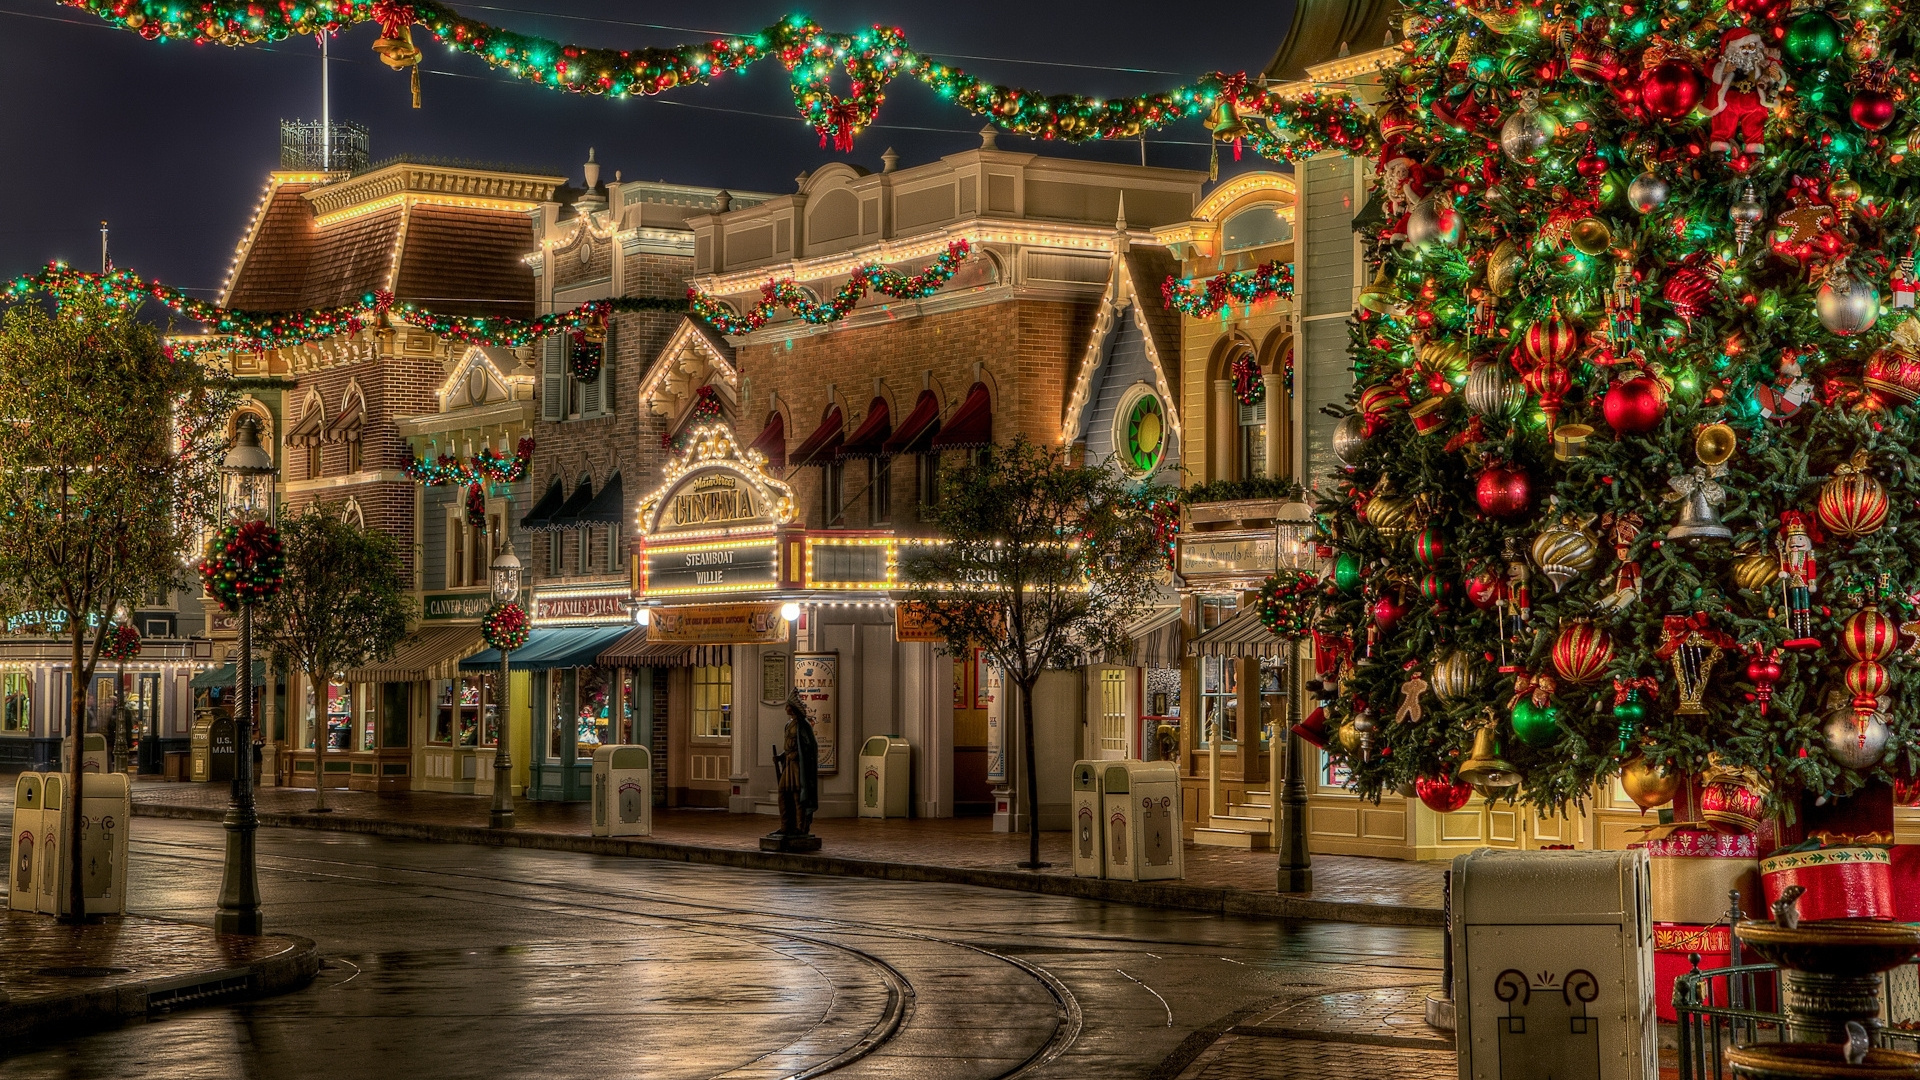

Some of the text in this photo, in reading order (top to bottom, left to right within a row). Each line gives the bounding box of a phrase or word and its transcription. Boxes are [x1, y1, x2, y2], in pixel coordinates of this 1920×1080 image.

[693, 474, 736, 491] Main Street
[674, 487, 756, 526] CINEMA
[686, 551, 734, 567] STEAMBOAT
[696, 570, 723, 584] WILLIE
[430, 600, 460, 615] CANNED
[795, 678, 834, 688] INEMA
[216, 736, 232, 744] U.S.
[212, 746, 235, 754] MAIL
